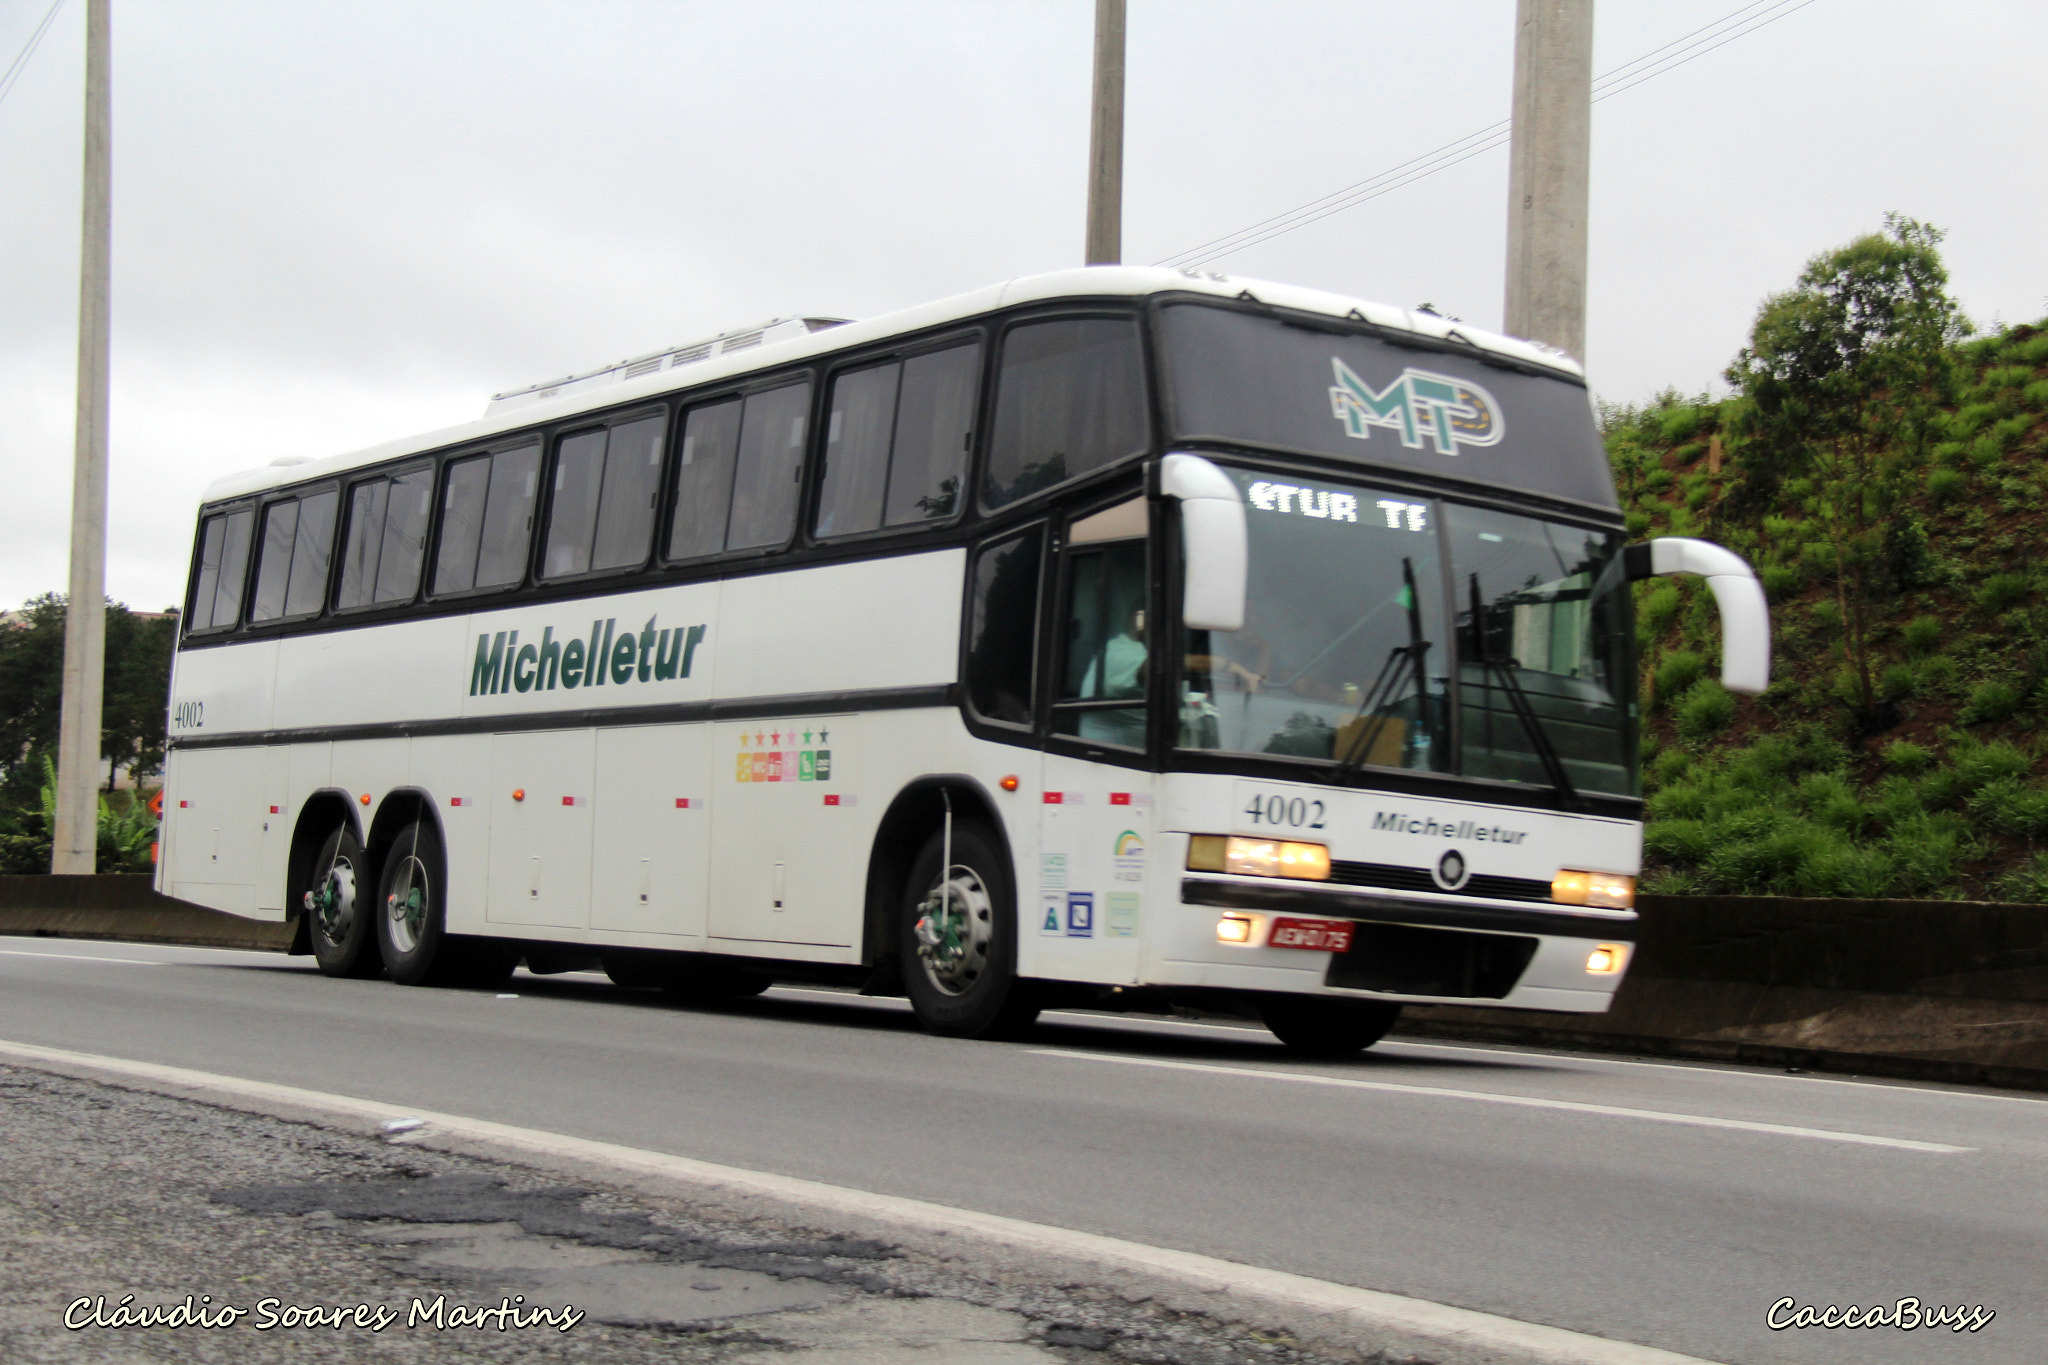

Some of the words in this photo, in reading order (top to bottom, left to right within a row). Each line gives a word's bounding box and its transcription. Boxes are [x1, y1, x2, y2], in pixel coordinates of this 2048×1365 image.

[469, 613, 708, 697] Michelletur
[174, 701, 204, 729] 4002
[1245, 793, 1328, 830] 4002
[1371, 811, 1529, 845] Michelletur
